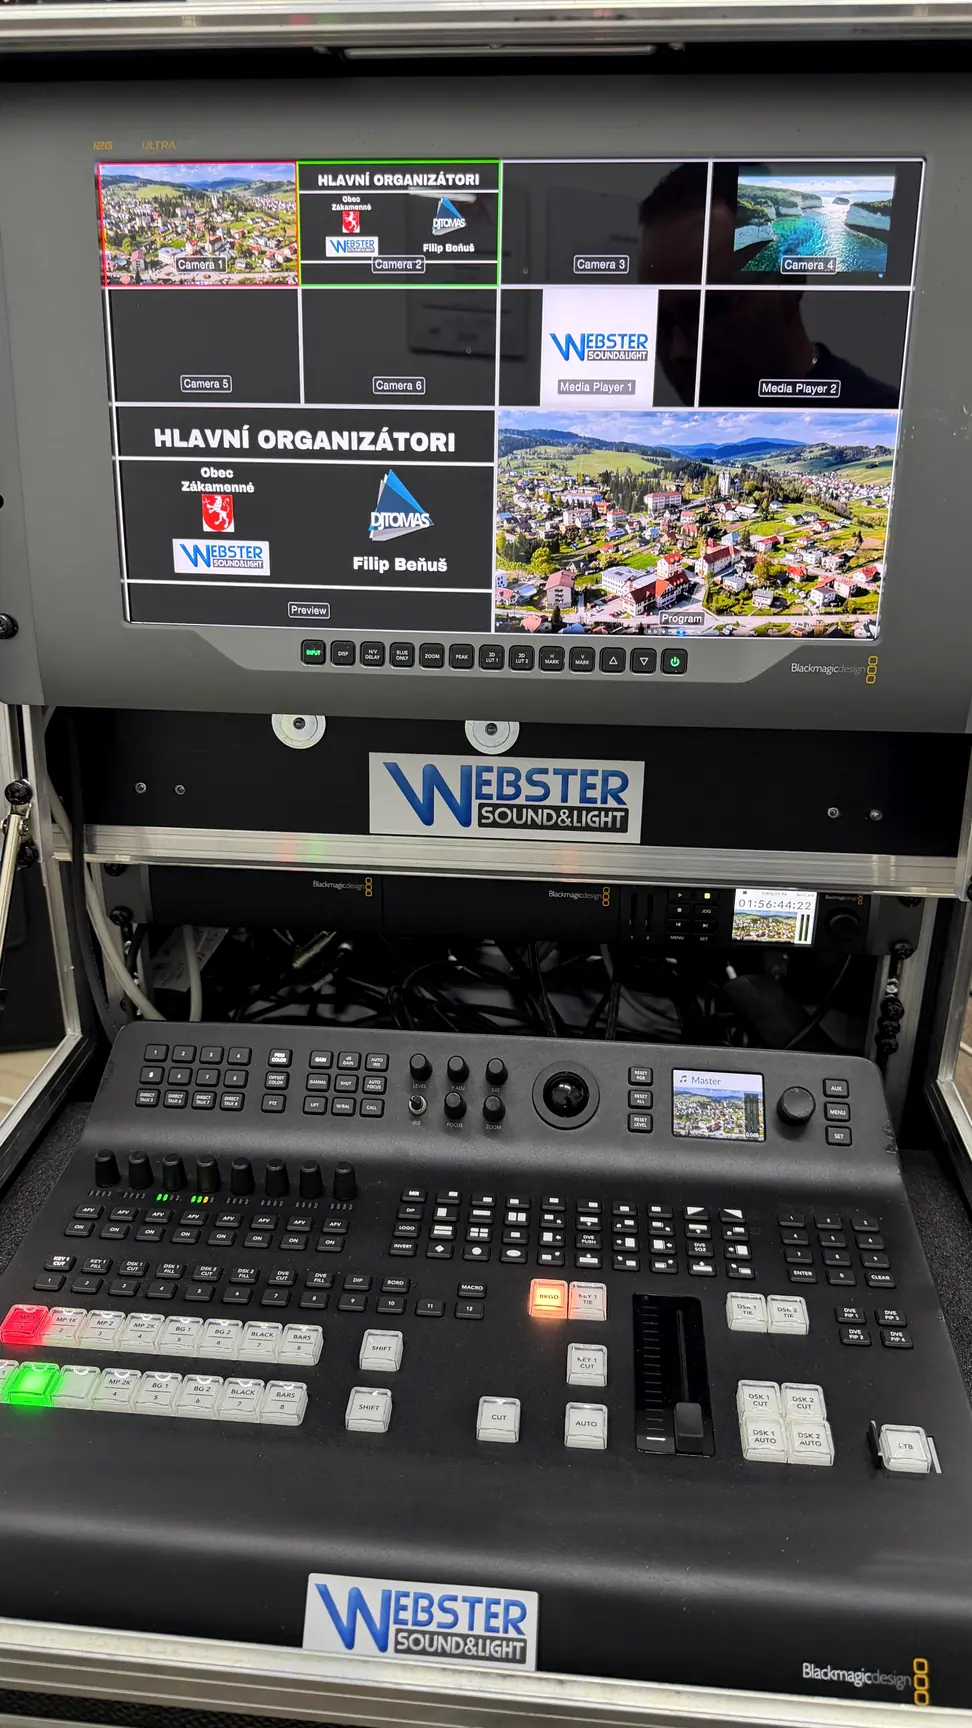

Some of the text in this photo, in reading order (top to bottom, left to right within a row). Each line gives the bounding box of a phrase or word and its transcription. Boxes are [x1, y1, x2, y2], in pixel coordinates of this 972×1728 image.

[93, 141, 113, 150] 12G
[141, 140, 176, 150] ULTRA
[318, 171, 479, 186] HLAVNÍ ORGANIZÁTORI
[329, 239, 375, 253] WEBSTER
[423, 244, 443, 254] Filip
[178, 258, 223, 270] Camera 1
[375, 260, 422, 270] Camera 2
[577, 259, 625, 270] Camera 3
[784, 259, 834, 270] Camera 4
[549, 333, 648, 362] WEBSTER
[587, 350, 647, 361] SOUND&LIGHT
[183, 378, 229, 389] Camera 5
[376, 380, 422, 391] Camera 6
[560, 381, 632, 395] Media Player 1
[762, 383, 836, 396] Media Player 2
[154, 425, 456, 452] HLAVNÍ ORGANIZÁTORI
[200, 467, 234, 478] Obec
[181, 480, 255, 494] Zákamenné
[179, 543, 263, 568] WEBSTER
[213, 559, 263, 569] SOUND&LIGHT
[353, 556, 447, 573] Filip Beňuš
[291, 605, 327, 616] Preview
[662, 614, 702, 625] Program
[791, 663, 866, 675] Blackmagicdesign
[383, 762, 629, 827] WEBSTER
[481, 806, 625, 828] SOUND&LIGHT
[312, 880, 365, 891] Blackmagicdesign
[548, 890, 602, 900] Blackmagicdesign
[738, 899, 812, 910] 01:56:44:22
[691, 1076, 721, 1085] Master
[315, 1583, 527, 1653] WEBSTER
[396, 1632, 524, 1660] SOUND&LIGHT
[802, 1662, 912, 1690] Blackmagicdesign
